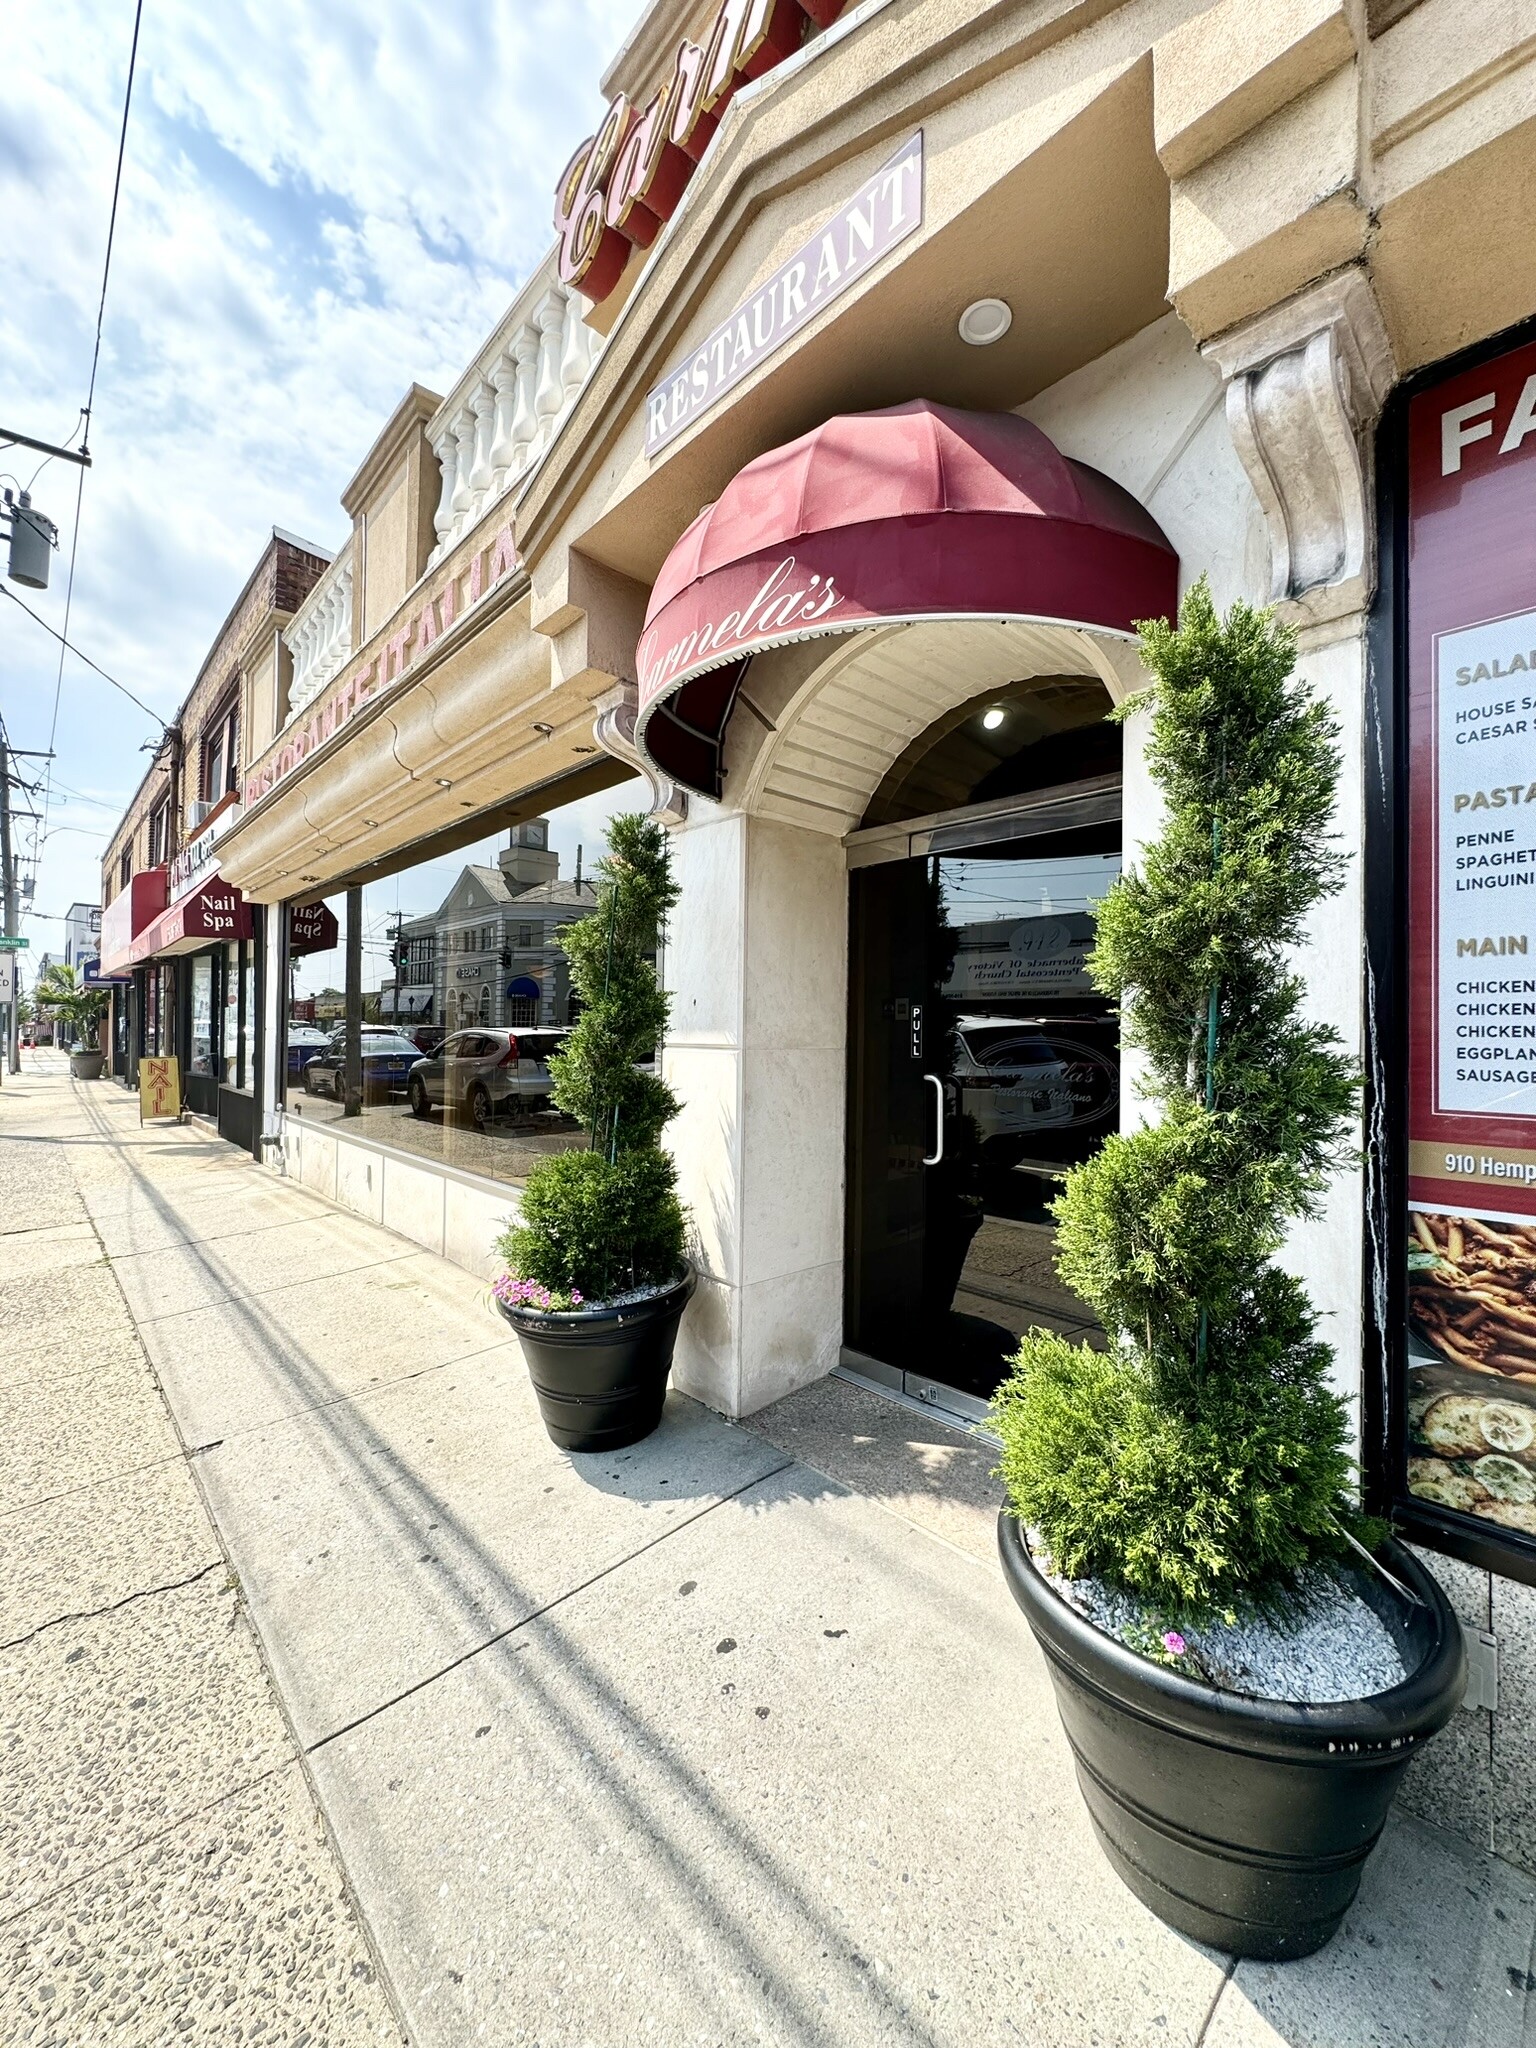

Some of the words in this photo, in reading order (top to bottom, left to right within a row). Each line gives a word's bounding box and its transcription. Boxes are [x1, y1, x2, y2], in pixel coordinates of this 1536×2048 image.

[647, 154, 915, 445] RESTAURANT
[1455, 700, 1516, 724] HOUSE
[1455, 720, 1528, 745] CAESAR
[1456, 829, 1515, 848] PENNE
[1456, 872, 1534, 891] LINGUINI
[200, 894, 236, 911] Nail
[203, 912, 234, 931] Spa
[1456, 935, 1528, 958] MAIN
[1456, 980, 1535, 994] CHICKEN
[1456, 1003, 1535, 1016] CHICKEN
[913, 1007, 921, 1056] PULL
[1456, 1025, 1535, 1038] CHICKEN
[148, 1059, 173, 1115] NAIL
[1047, 1087, 1092, 1103] Italiano
[1445, 1153, 1475, 1174] 910
[1480, 1156, 1536, 1184] Hemp
